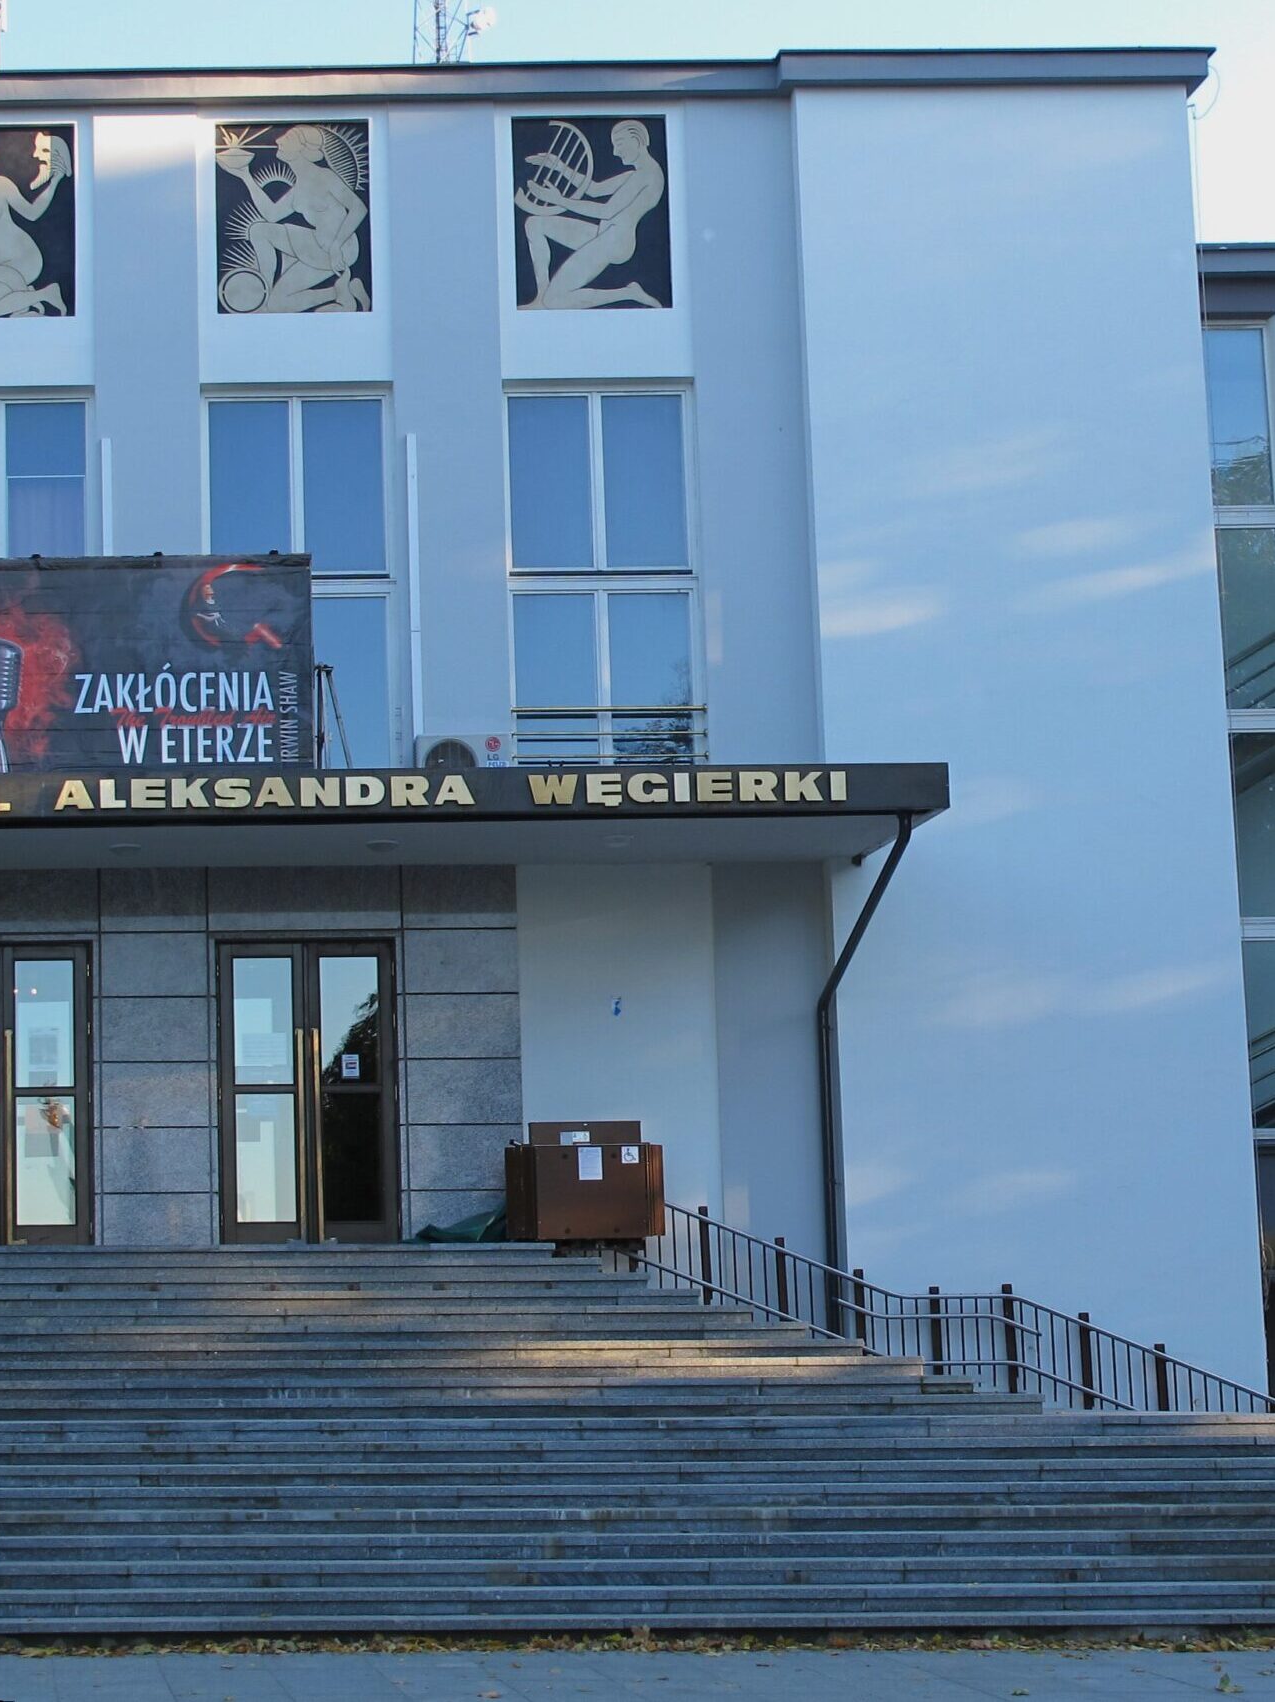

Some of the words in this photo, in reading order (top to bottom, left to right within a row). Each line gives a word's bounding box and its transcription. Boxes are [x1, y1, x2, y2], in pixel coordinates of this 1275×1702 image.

[75, 662, 274, 713] ZAKŁÓCENIA
[279, 670, 298, 713] SHAW
[111, 706, 146, 727] The
[153, 706, 235, 727] Troubled
[118, 724, 149, 764] W
[161, 723, 274, 763] ETERZE
[280, 719, 299, 763] IRWIN
[487, 753, 500, 761] LG
[53, 775, 476, 811] ALEKSANDRA
[527, 770, 848, 807] WĘGIERKI
